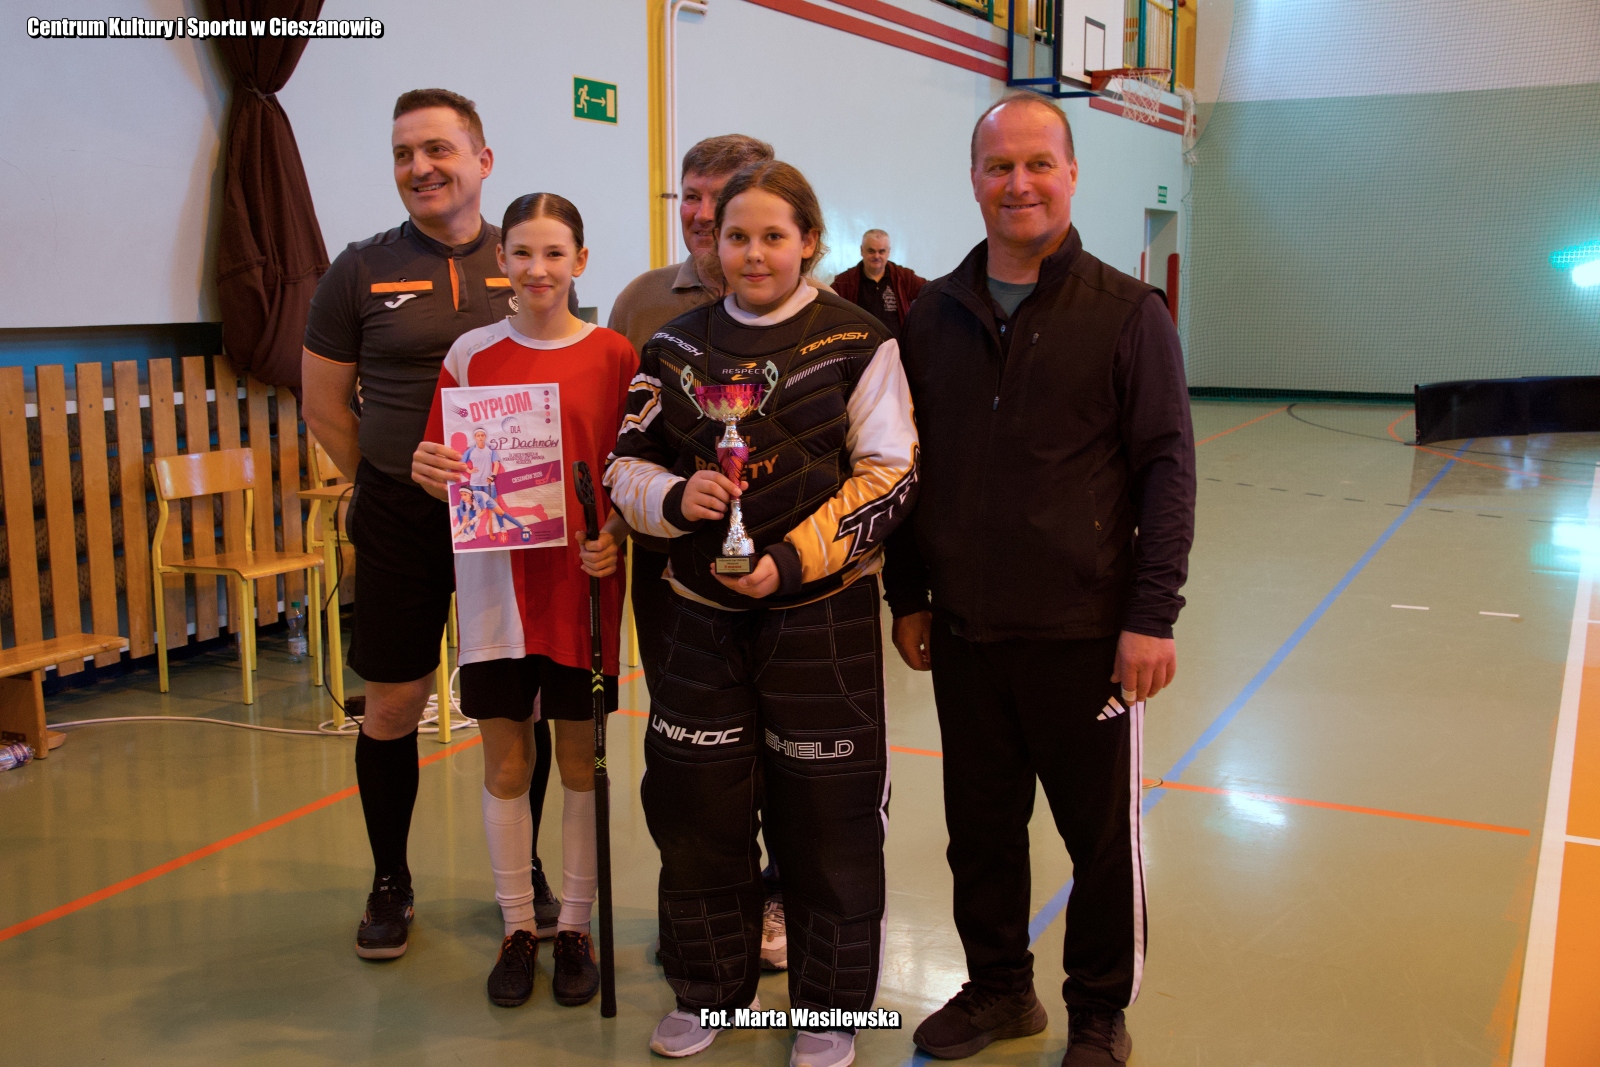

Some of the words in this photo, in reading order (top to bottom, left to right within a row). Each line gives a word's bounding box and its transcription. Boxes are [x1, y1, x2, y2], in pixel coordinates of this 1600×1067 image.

[652, 331, 704, 357] TEMPISH
[800, 331, 869, 355] TEMPISH
[469, 391, 533, 423] DYPLOM
[488, 436, 508, 451] SP
[510, 435, 559, 450] Dachnów
[511, 426, 521, 434] DLA
[652, 714, 743, 746] UNIHOC
[765, 728, 855, 760] SHIELD
